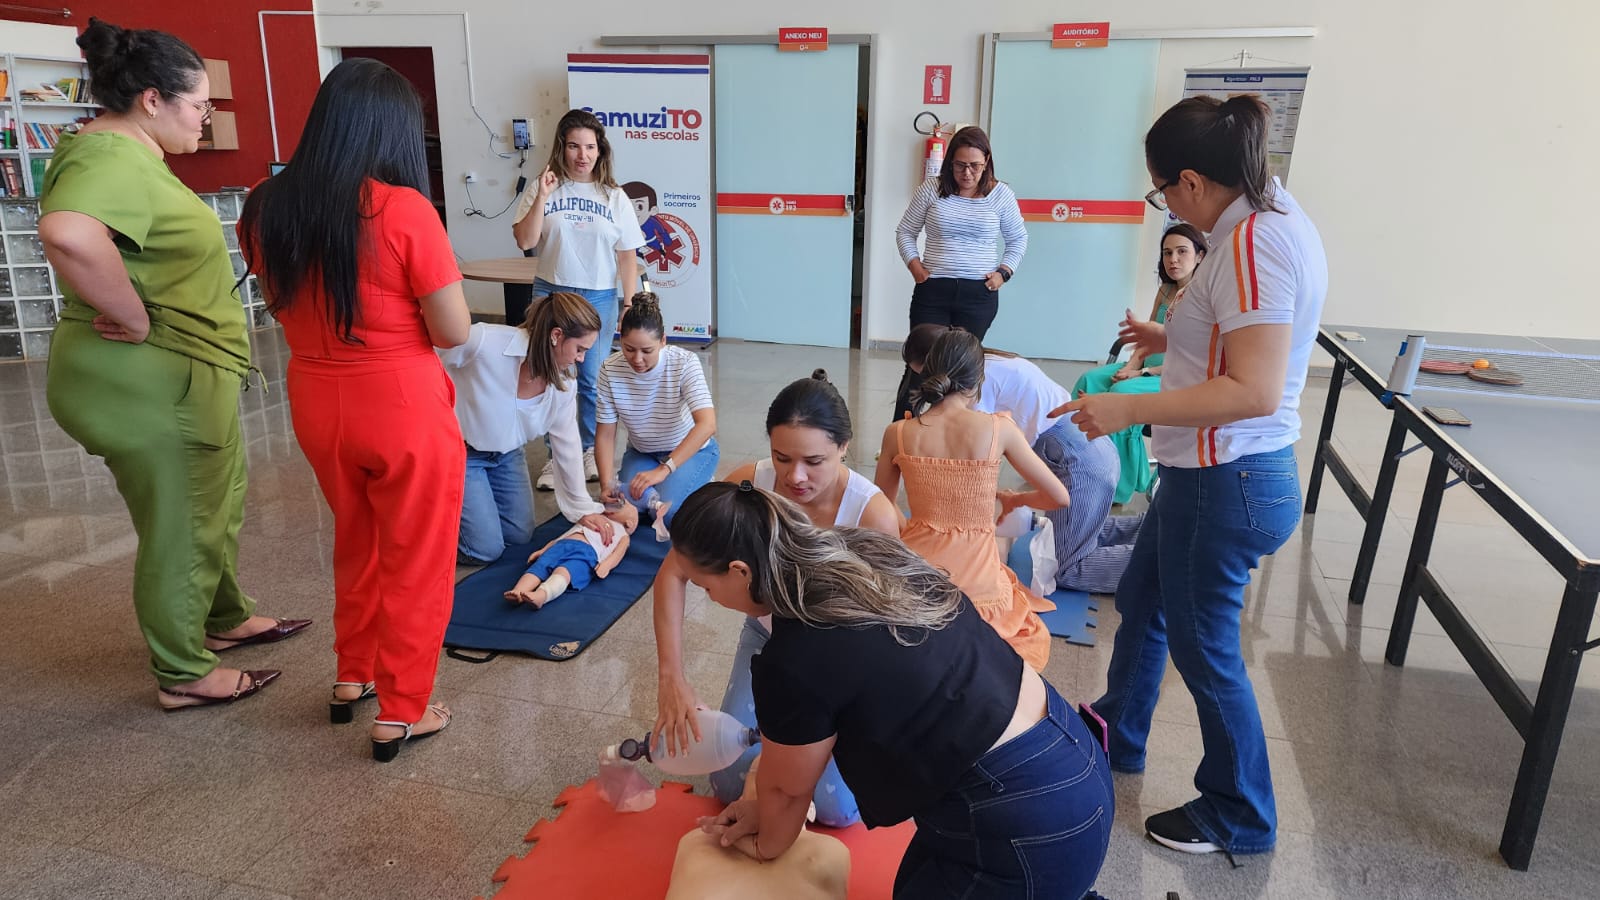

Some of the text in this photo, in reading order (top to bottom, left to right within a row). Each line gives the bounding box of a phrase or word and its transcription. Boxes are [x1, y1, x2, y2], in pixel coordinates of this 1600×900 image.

[1063, 28, 1099, 36] AUDITÓRIO
[625, 130, 699, 141] nas escolas
[663, 192, 701, 200] Primeiros
[544, 197, 614, 223] CALIFORNIA
